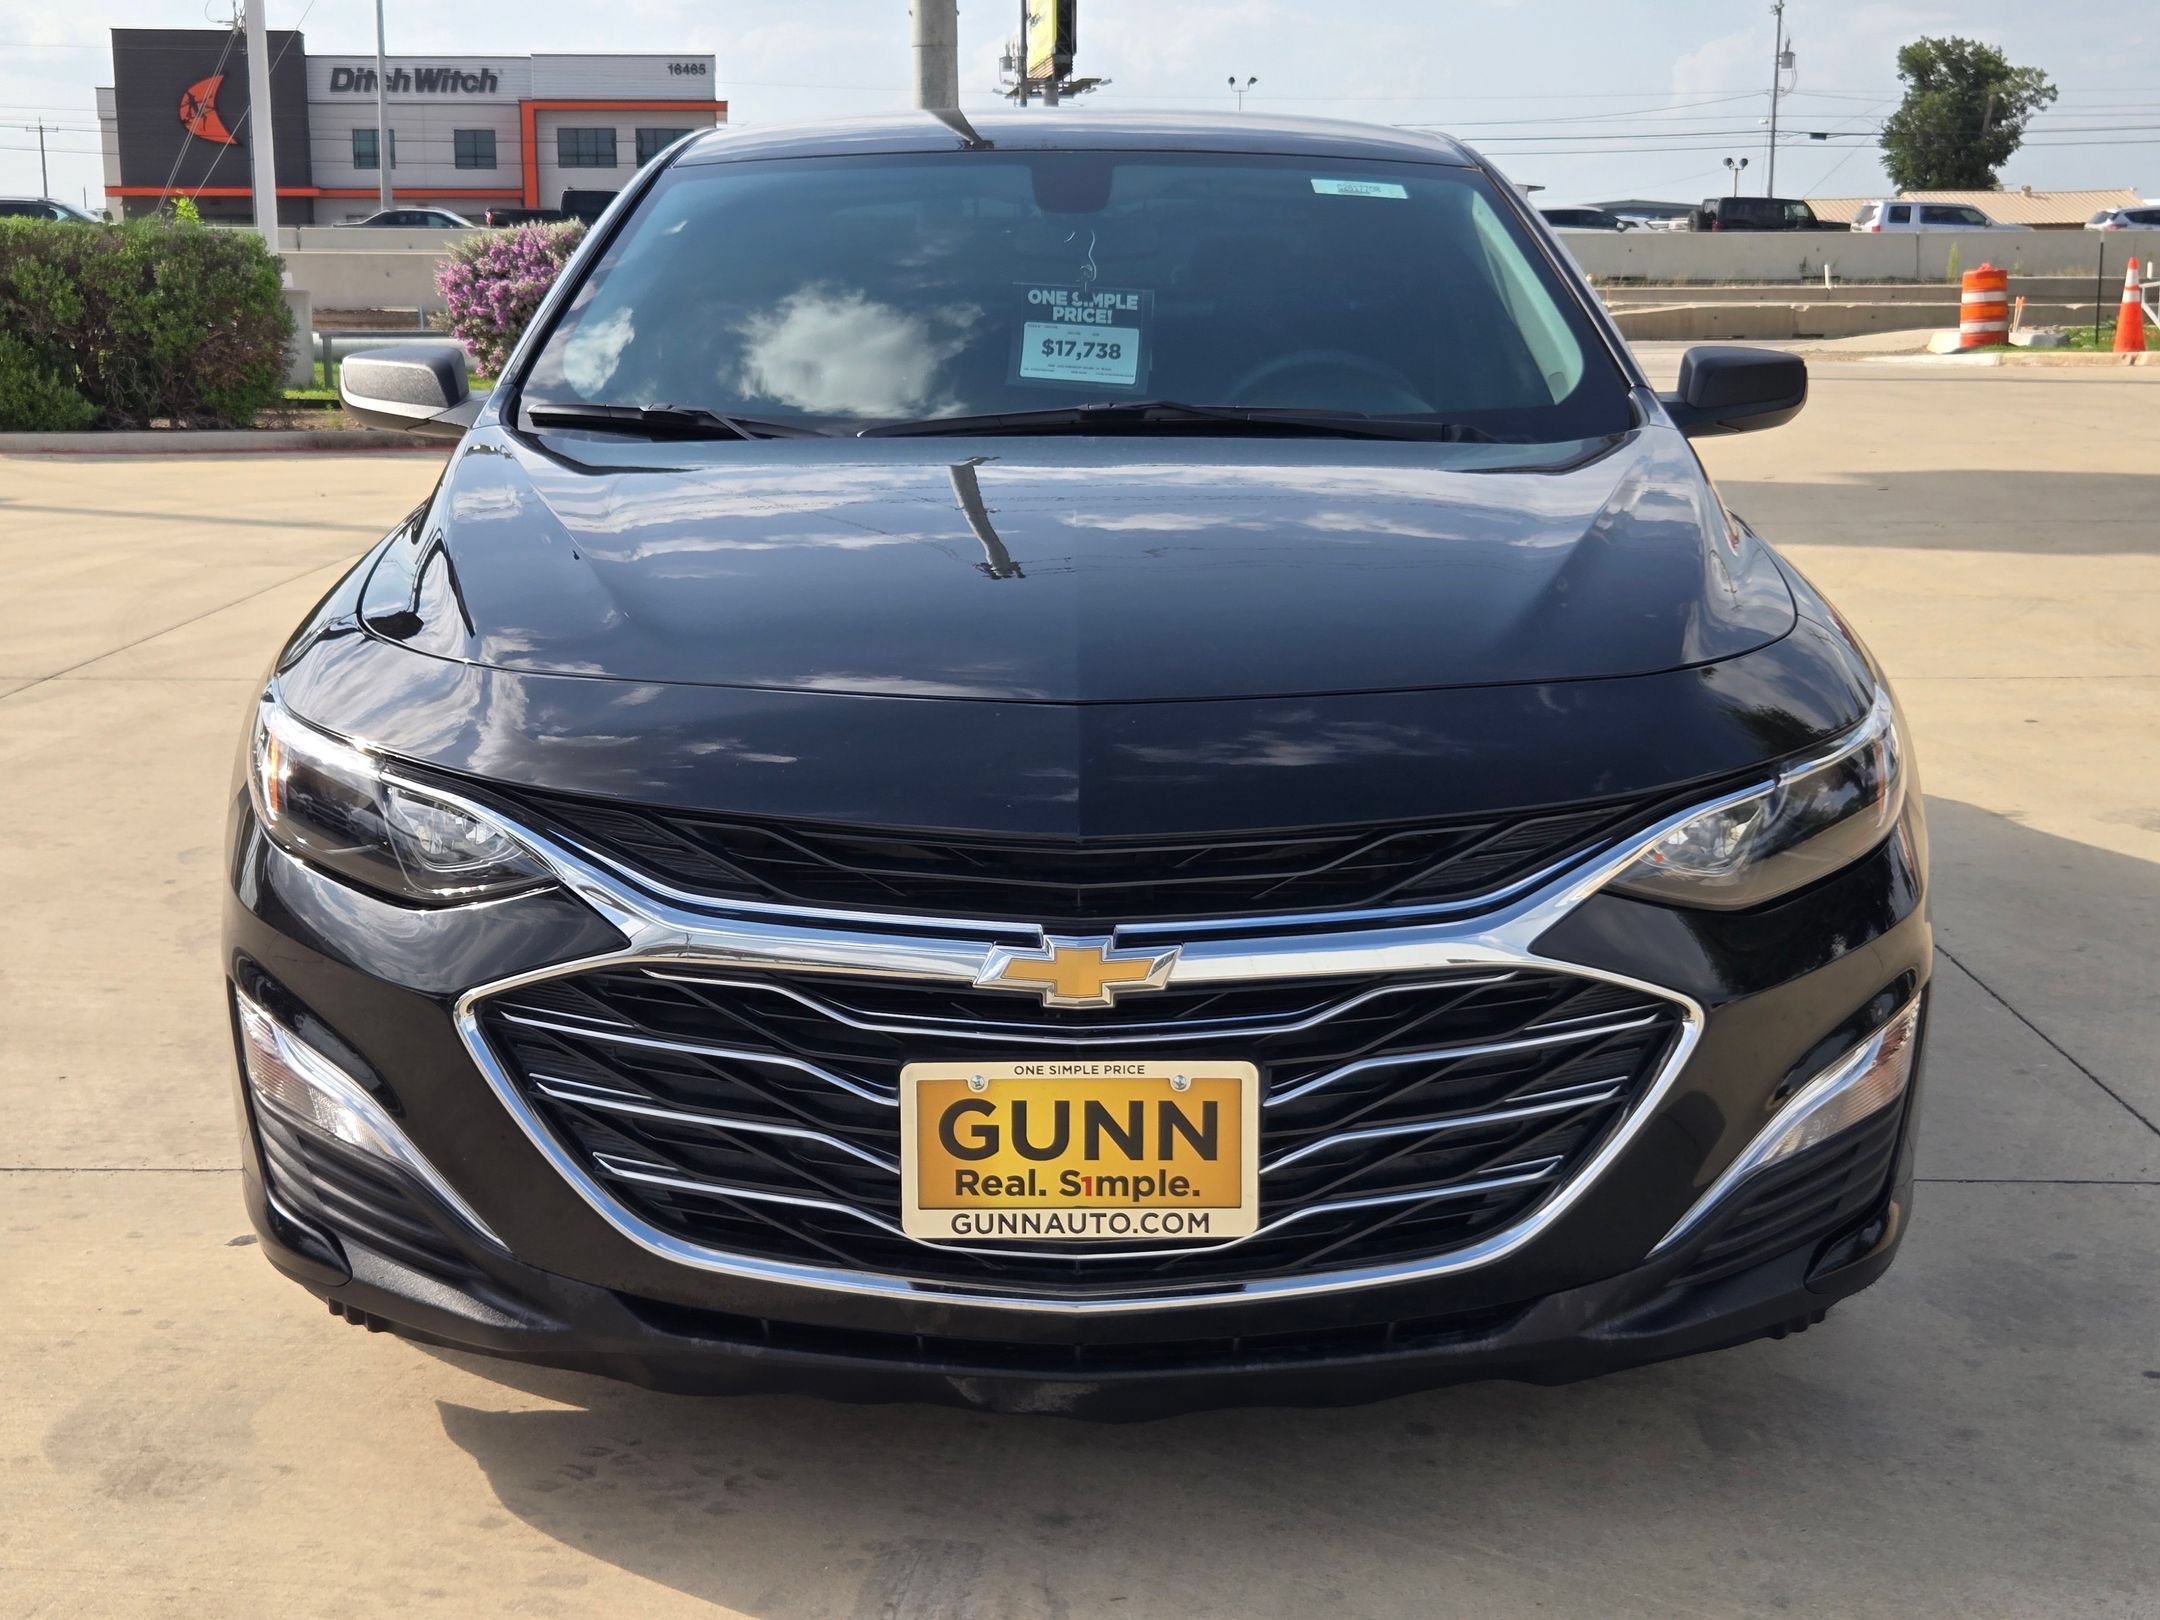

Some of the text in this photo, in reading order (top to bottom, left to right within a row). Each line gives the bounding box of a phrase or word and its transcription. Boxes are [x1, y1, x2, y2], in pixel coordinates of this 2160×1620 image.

[414, 67, 498, 93] Witch
[667, 63, 706, 76] 16465
[1027, 289, 1139, 311] ONE SMPLE
[1052, 306, 1113, 324] PRICE!
[1041, 338, 1122, 360] $17,738
[1014, 1065, 1145, 1076] ONE SIMPLE PRICE
[938, 1098, 1218, 1161] GUNN
[955, 1169, 1201, 1202] Real. S1mple.
[950, 1212, 1210, 1234] GUNNAUTO.COM
